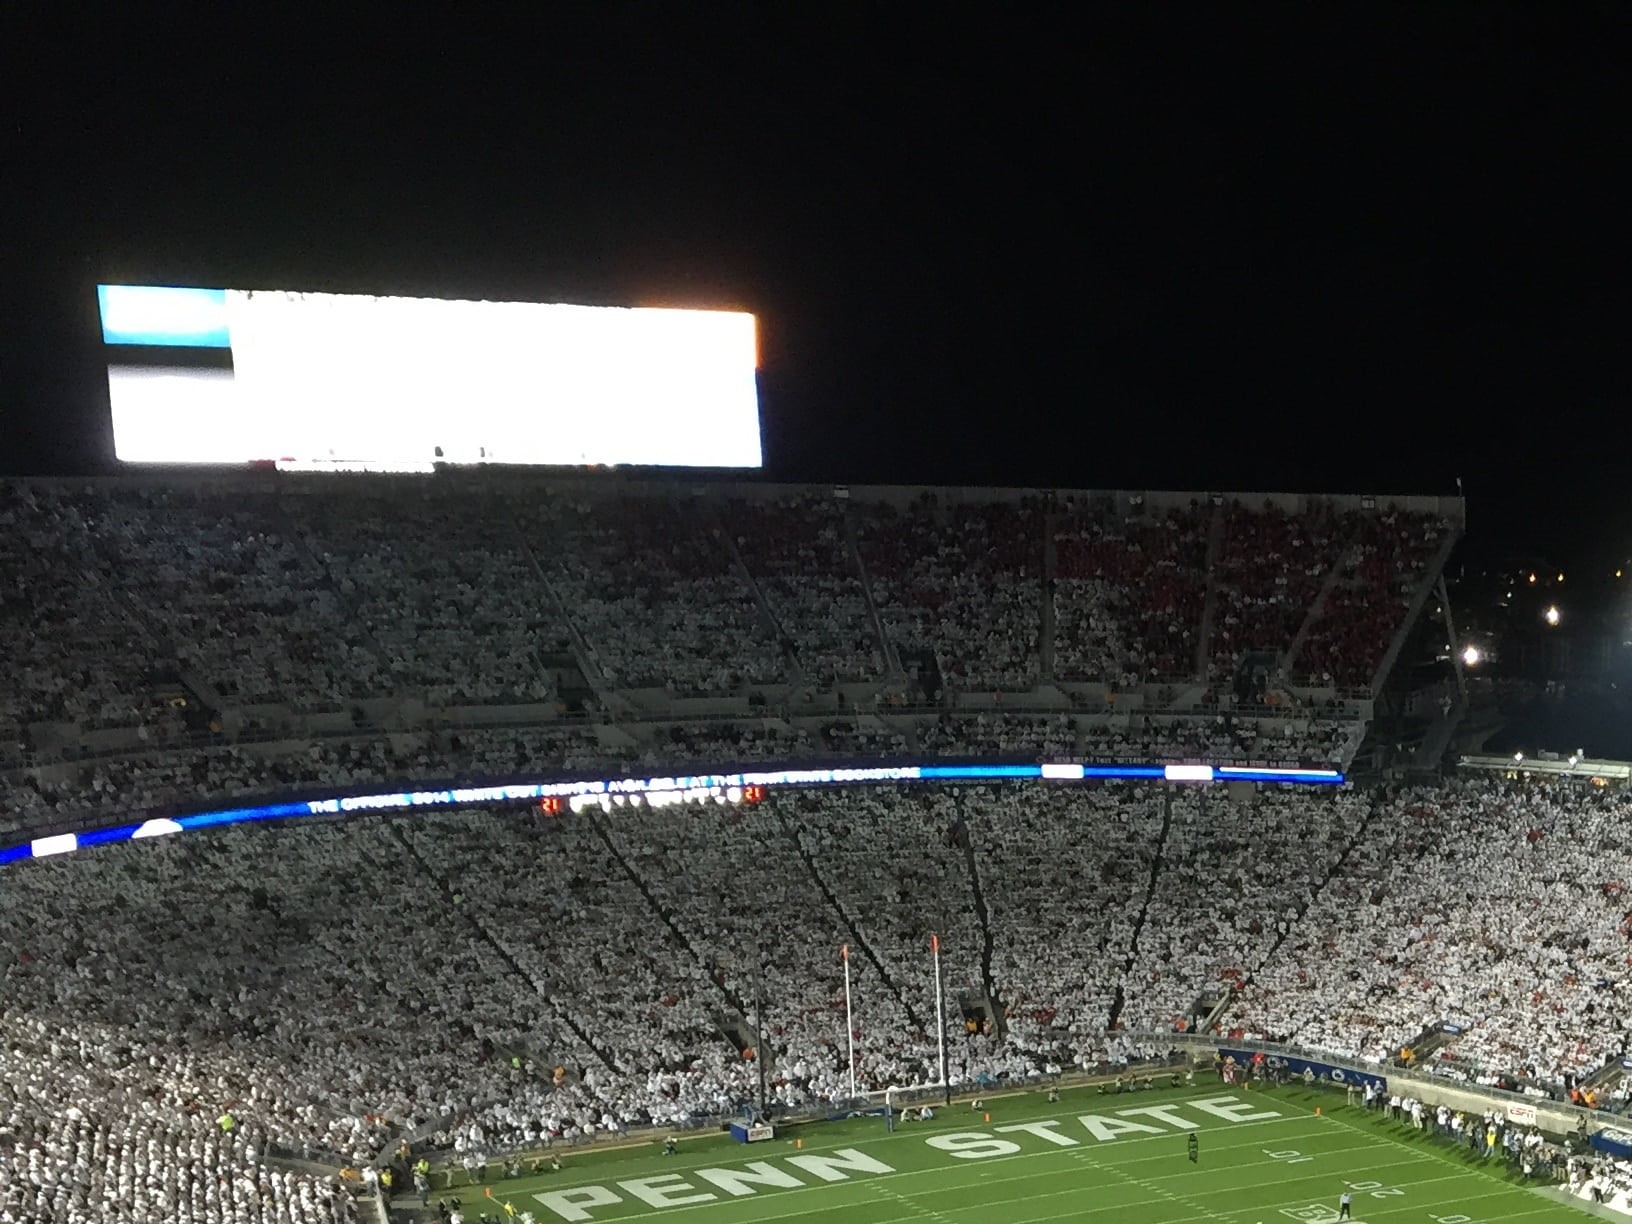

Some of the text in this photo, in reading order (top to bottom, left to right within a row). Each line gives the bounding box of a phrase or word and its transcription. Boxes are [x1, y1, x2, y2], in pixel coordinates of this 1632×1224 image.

[745, 786, 760, 799] 21
[543, 798, 557, 811] 21
[532, 1095, 1283, 1222] PENN STATE
[1269, 1150, 1314, 1164] 10
[1350, 1181, 1405, 1198] 20
